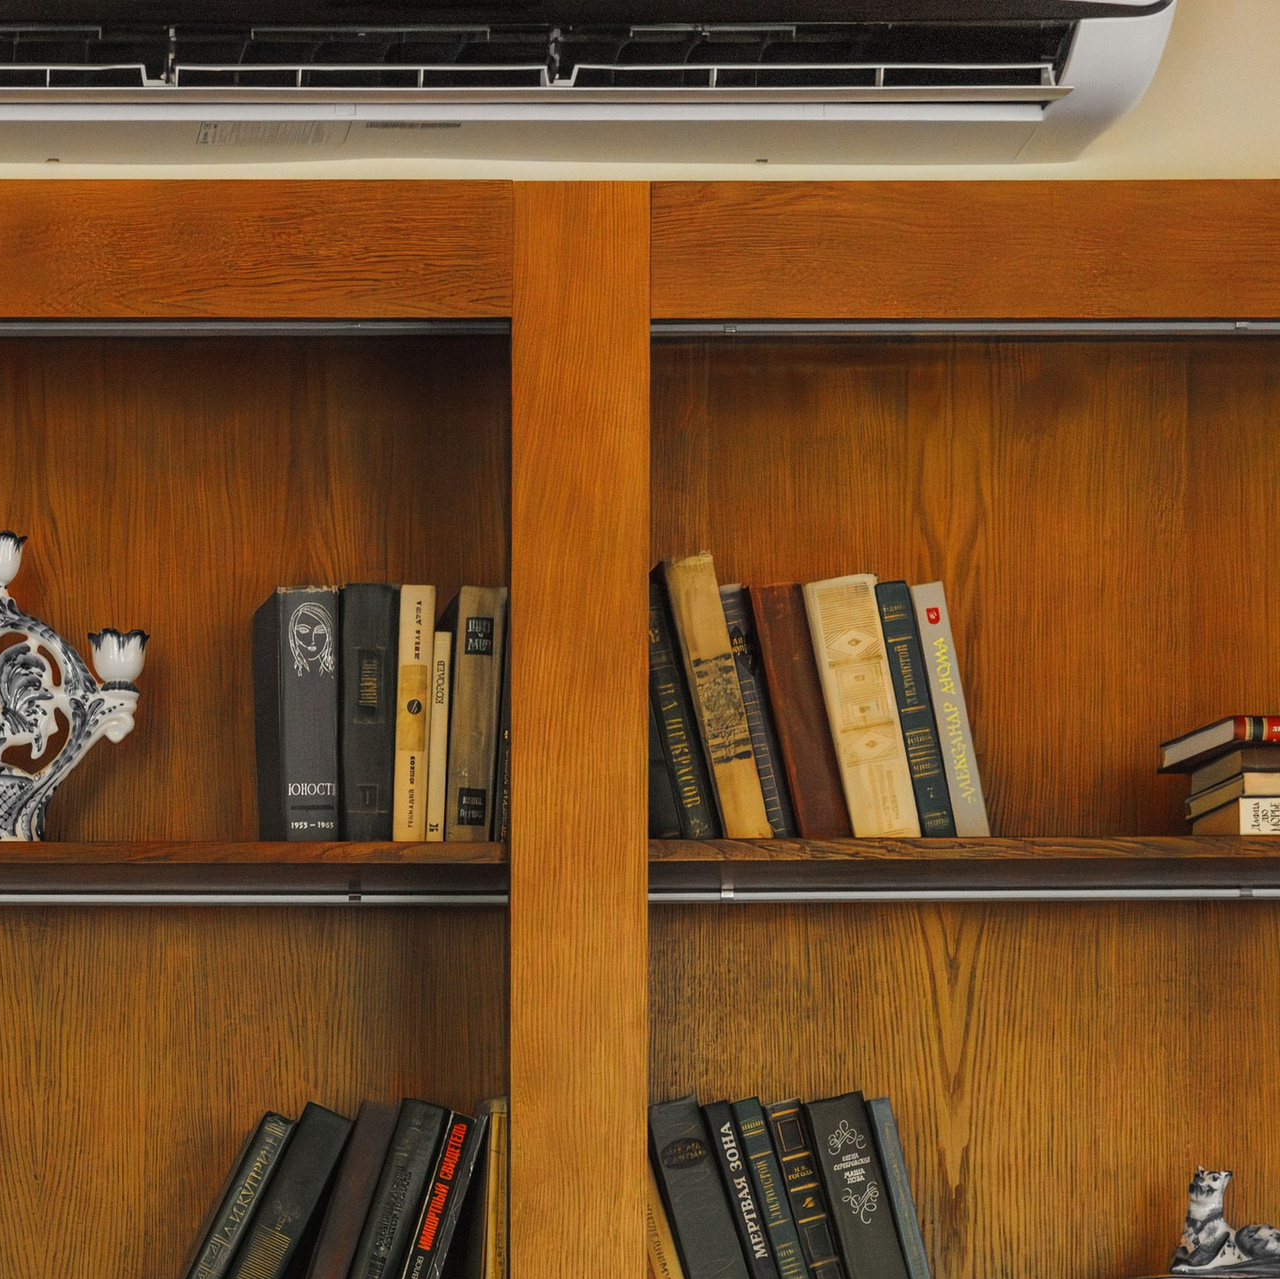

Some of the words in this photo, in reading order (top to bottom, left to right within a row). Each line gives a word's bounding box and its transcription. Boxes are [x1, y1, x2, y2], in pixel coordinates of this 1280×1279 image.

[435, 660, 445, 704] КОРОЛЕВ
[932, 637, 957, 695] ДЮМА
[665, 718, 701, 808] НЕКРАСОВ
[943, 702, 976, 804] АЛЕКСАНДР
[1251, 802, 1261, 832] ДАФНА
[1261, 808, 1270, 824] ДЮ
[720, 1121, 743, 1173] ЗОНА
[417, 1181, 451, 1251] ИМПОРТНЫЙ
[438, 1122, 469, 1180] СВИДЕТЕЛЬ
[788, 1169, 814, 1181] ГОГОЛЬ
[734, 1178, 769, 1260] МЕРТВАЯ
